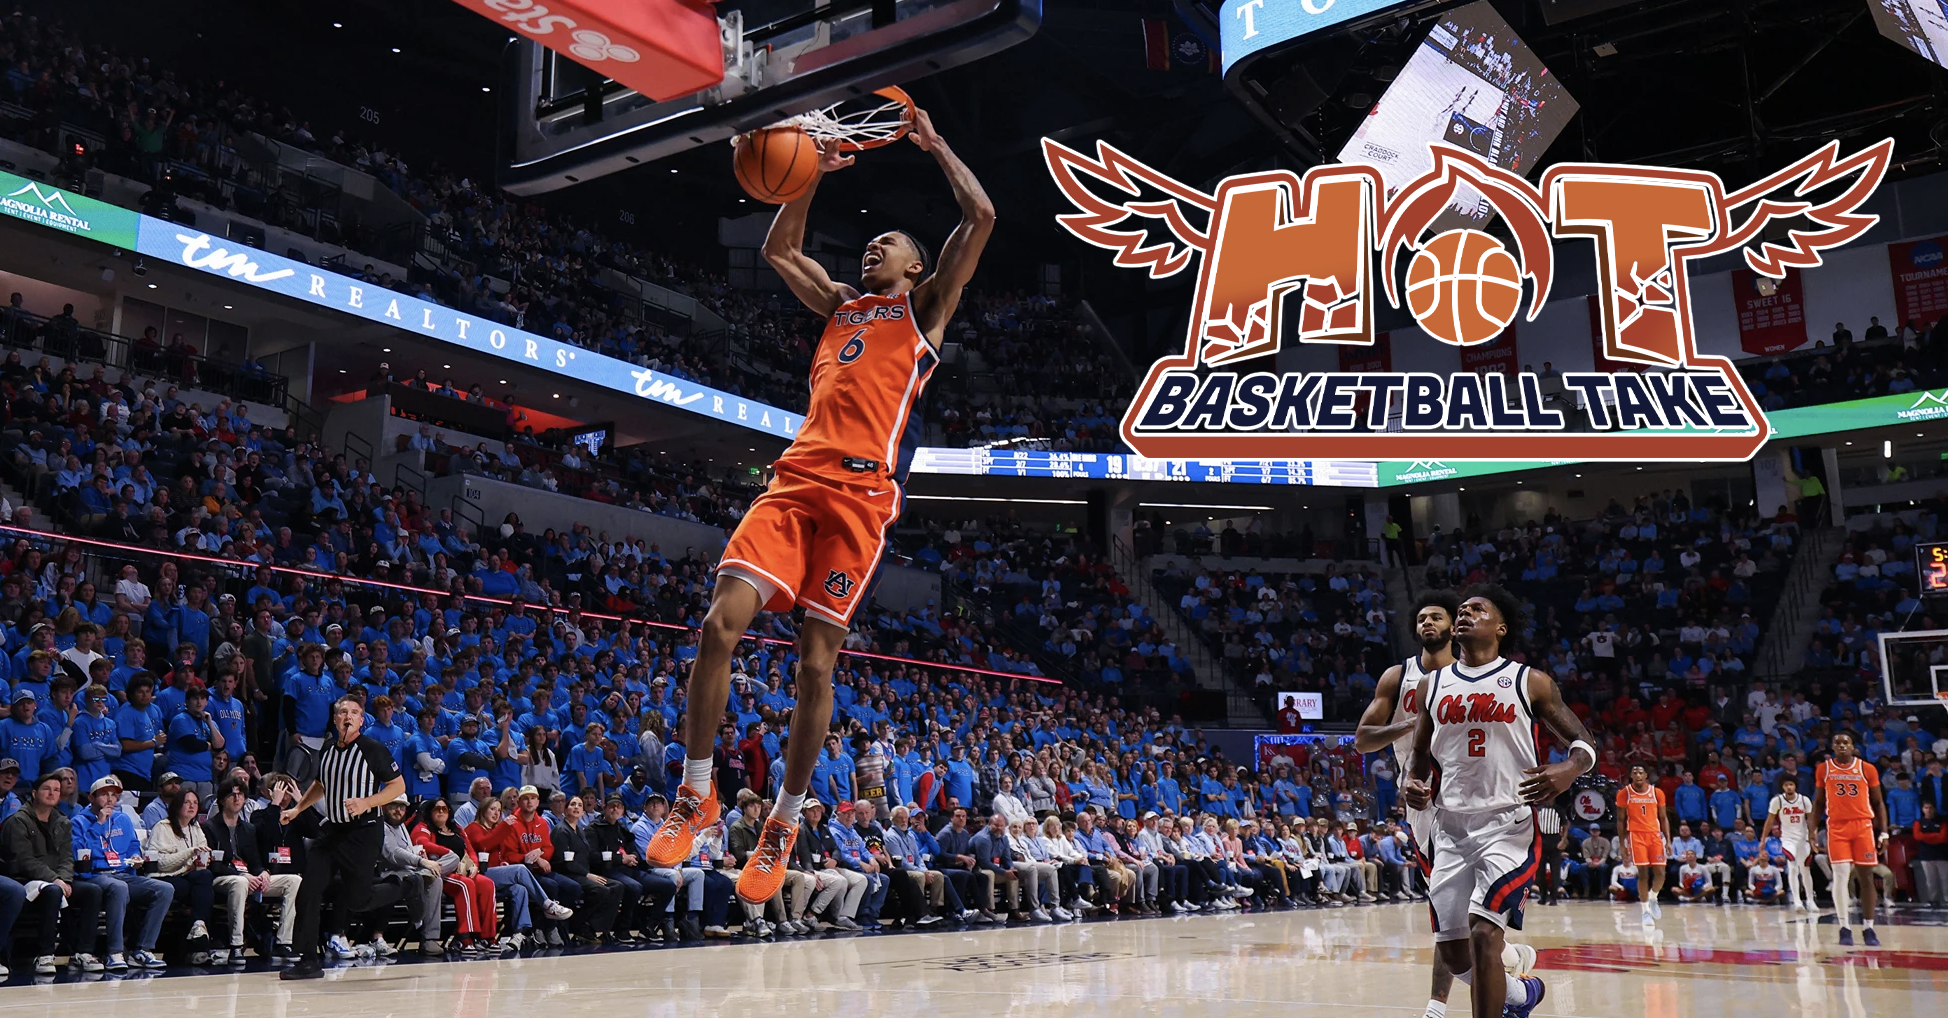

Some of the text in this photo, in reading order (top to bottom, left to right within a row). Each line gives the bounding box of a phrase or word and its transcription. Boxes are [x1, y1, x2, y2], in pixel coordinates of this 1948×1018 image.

[359, 105, 380, 125] 205
[1363, 143, 1399, 159] CRADDOCK
[1367, 150, 1391, 162] COURT
[4, 206, 77, 233] TENT EVENT EQUIPMENT
[49, 211, 91, 231] RENTAL
[619, 208, 635, 226] 206
[1913, 251, 1944, 265] NCAA
[1746, 293, 1792, 310] SWEET 16
[835, 304, 906, 327] TIGERS
[837, 328, 868, 364] 6
[1764, 344, 1786, 353] WOMEN
[1465, 346, 1513, 364] CHAMPIONS
[1896, 406, 1945, 419] MAGNOLIA
[1078, 463, 1084, 472] 4
[1106, 455, 1123, 474] 19
[1172, 460, 1187, 476] 21
[1208, 467, 1214, 475] 2
[1052, 470, 1070, 478] 100%
[1395, 468, 1458, 481] MAGNOLIA RENTAL
[468, 488, 480, 499] 104
[1437, 692, 1517, 725] Ole Miss
[1468, 728, 1486, 758] 2
[1835, 783, 1859, 797] 33
[1580, 795, 1592, 805] Ole
[1583, 804, 1601, 815] Miss
[1641, 804, 1647, 816] 1
[1790, 815, 1800, 824] 23
